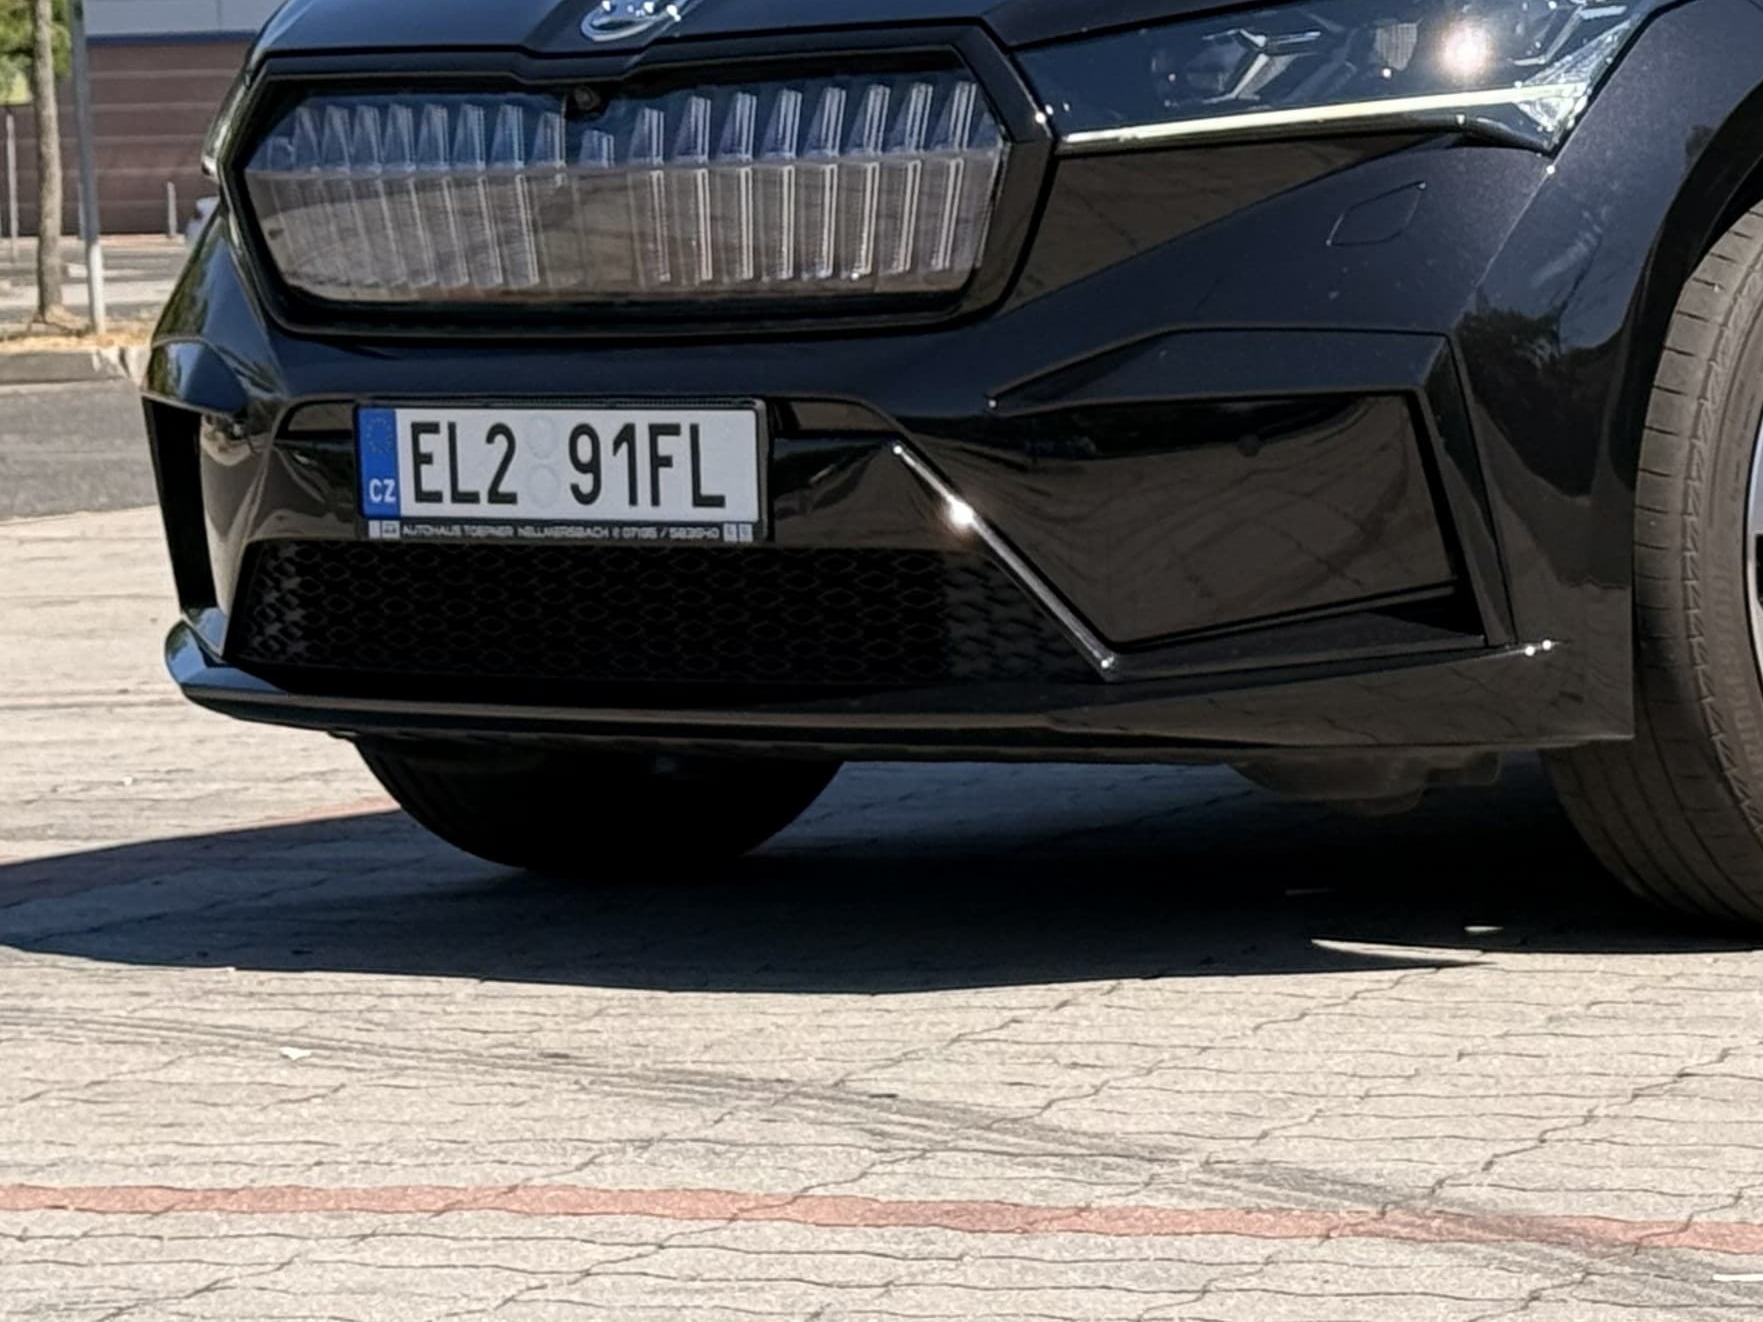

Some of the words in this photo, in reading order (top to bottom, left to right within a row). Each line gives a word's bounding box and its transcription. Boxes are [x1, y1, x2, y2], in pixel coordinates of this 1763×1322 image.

[368, 478, 397, 504] CZ
[410, 421, 518, 505] EL2
[568, 422, 727, 509] 91FL
